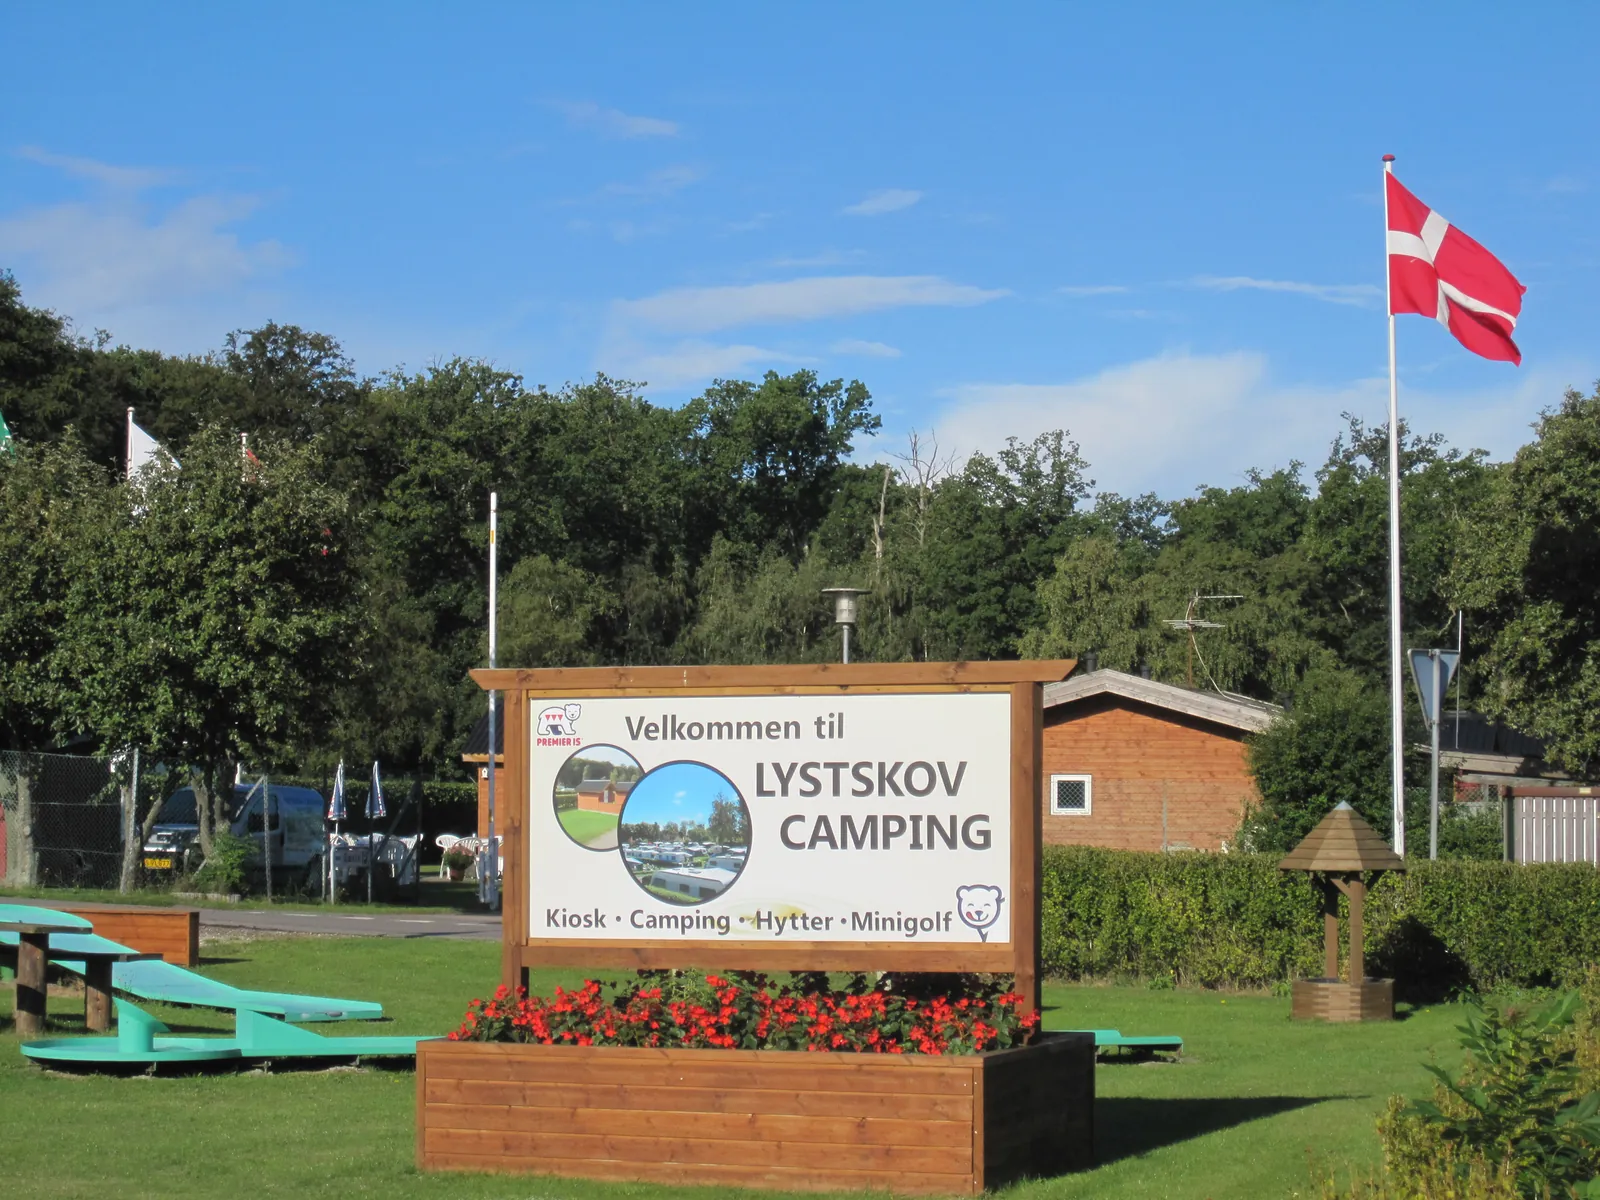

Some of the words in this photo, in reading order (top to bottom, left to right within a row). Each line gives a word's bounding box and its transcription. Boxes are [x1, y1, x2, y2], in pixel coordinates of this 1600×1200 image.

[537, 737, 571, 746] PREMIER
[573, 737, 581, 746] IS
[625, 714, 801, 741] Velkommen
[814, 712, 844, 739] til
[756, 761, 968, 797] LYSTSKOV
[780, 814, 992, 850] CAMPING
[546, 908, 606, 928] Kiosk
[630, 909, 731, 936] Camping
[756, 911, 834, 936] Hytter
[851, 911, 952, 938] Minigolf
